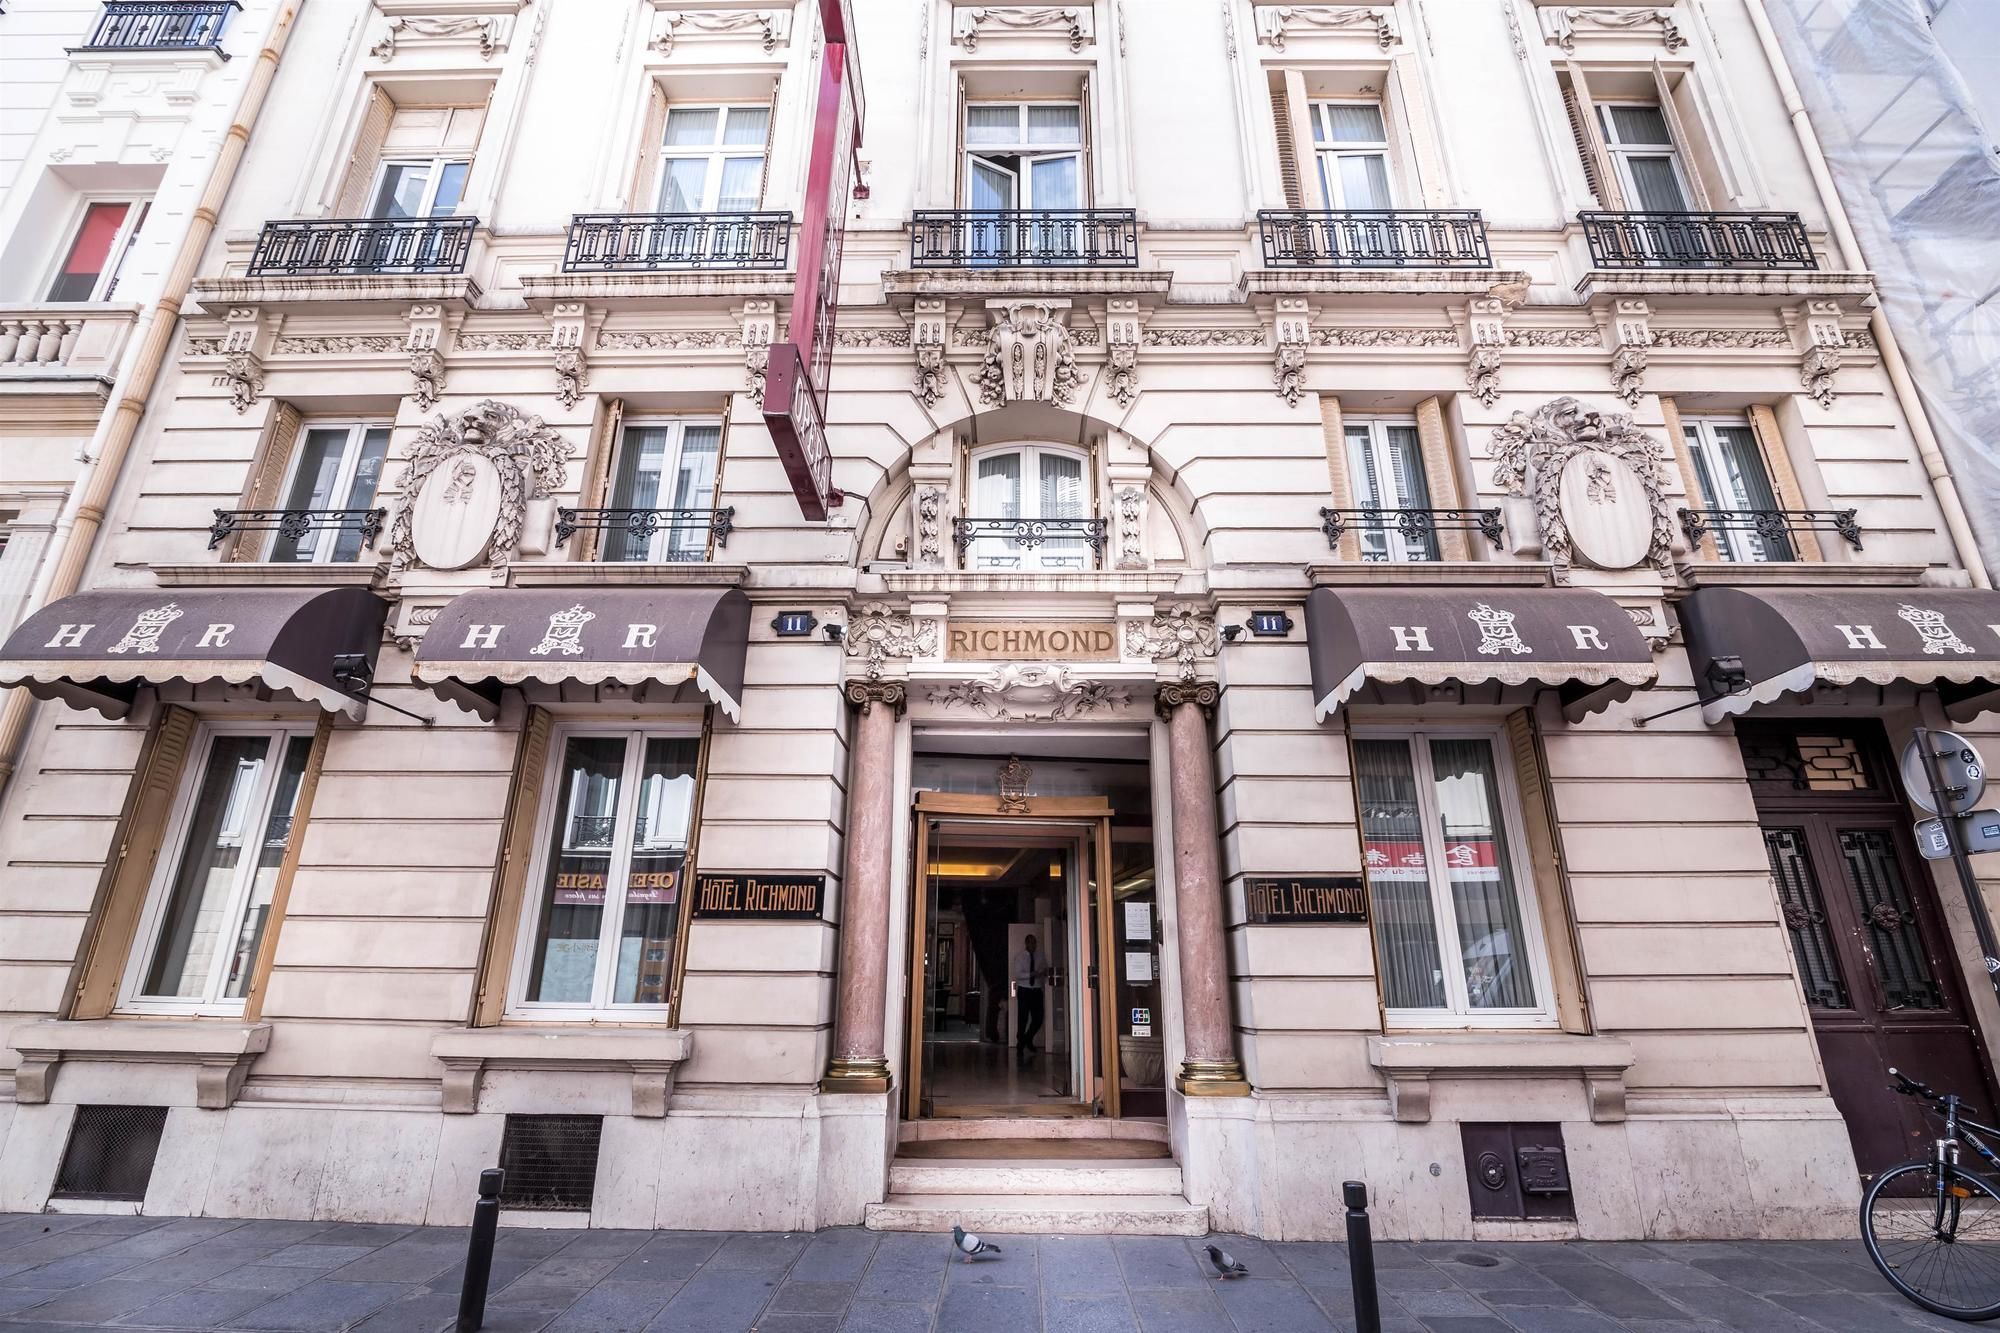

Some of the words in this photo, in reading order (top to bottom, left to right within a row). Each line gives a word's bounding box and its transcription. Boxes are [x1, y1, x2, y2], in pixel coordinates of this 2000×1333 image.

[795, 375, 828, 498] OPERA
[44, 623, 96, 648] H
[195, 623, 235, 648] R
[786, 615, 802, 631] 11
[1262, 616, 1278, 631] 11
[459, 624, 506, 649] H
[621, 623, 658, 648] R
[949, 630, 1115, 653] RICHMOND
[1389, 626, 1435, 651] H
[1566, 625, 1609, 651] R
[1834, 624, 1887, 649] H
[745, 879, 817, 911] RICHMOND
[1291, 882, 1365, 914] RICHMOND
